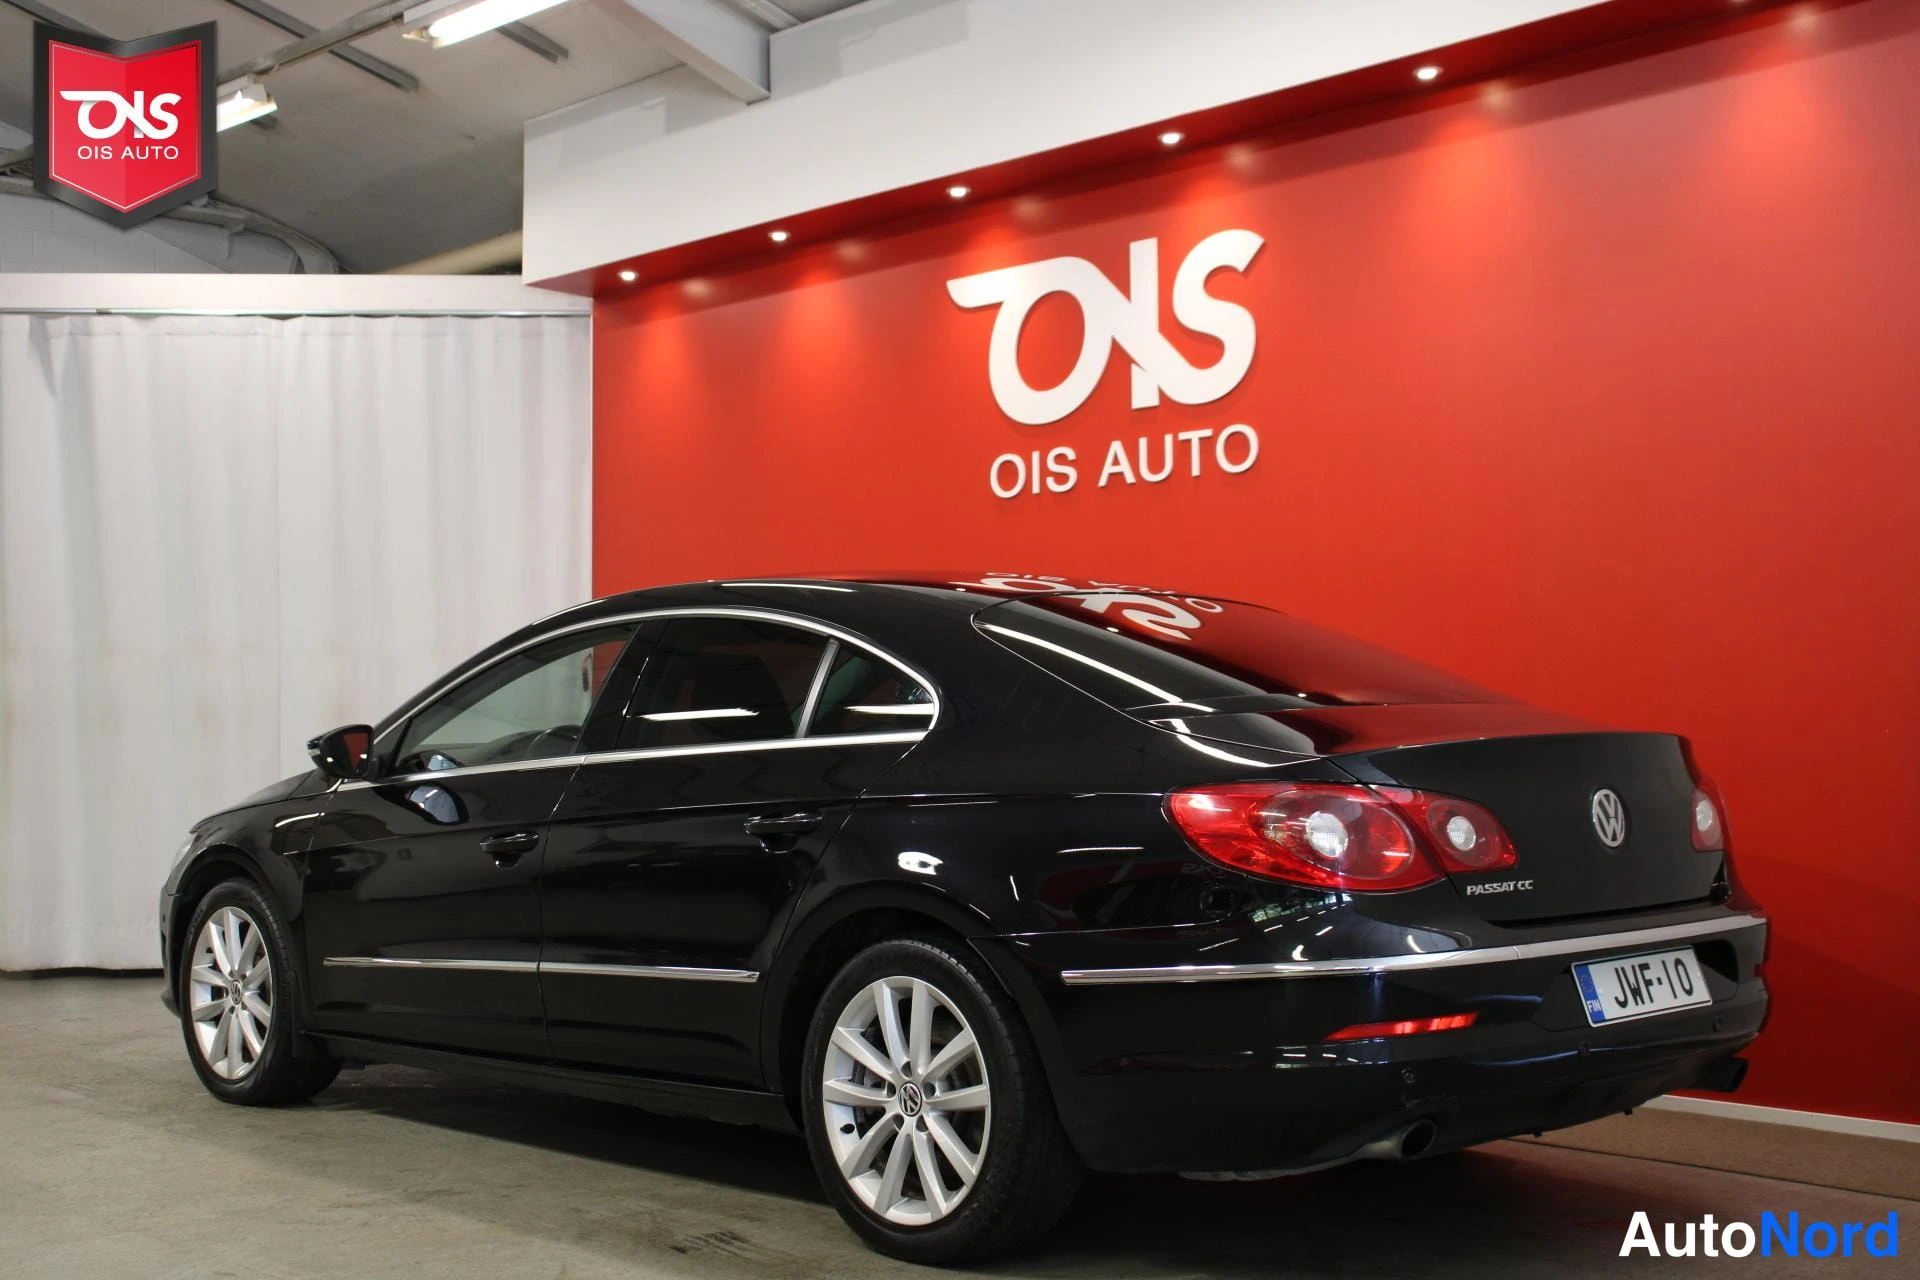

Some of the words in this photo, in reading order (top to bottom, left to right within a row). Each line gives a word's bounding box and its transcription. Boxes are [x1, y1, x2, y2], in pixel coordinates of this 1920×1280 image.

[946, 229, 1265, 425] OIS
[989, 446, 1078, 499] OIS
[1098, 424, 1259, 487] AUTO
[1466, 880, 1517, 896] PASSAT
[1517, 879, 1534, 891] CC
[1586, 999, 1603, 1013] FIN
[1613, 957, 1694, 1009] JWF-10
